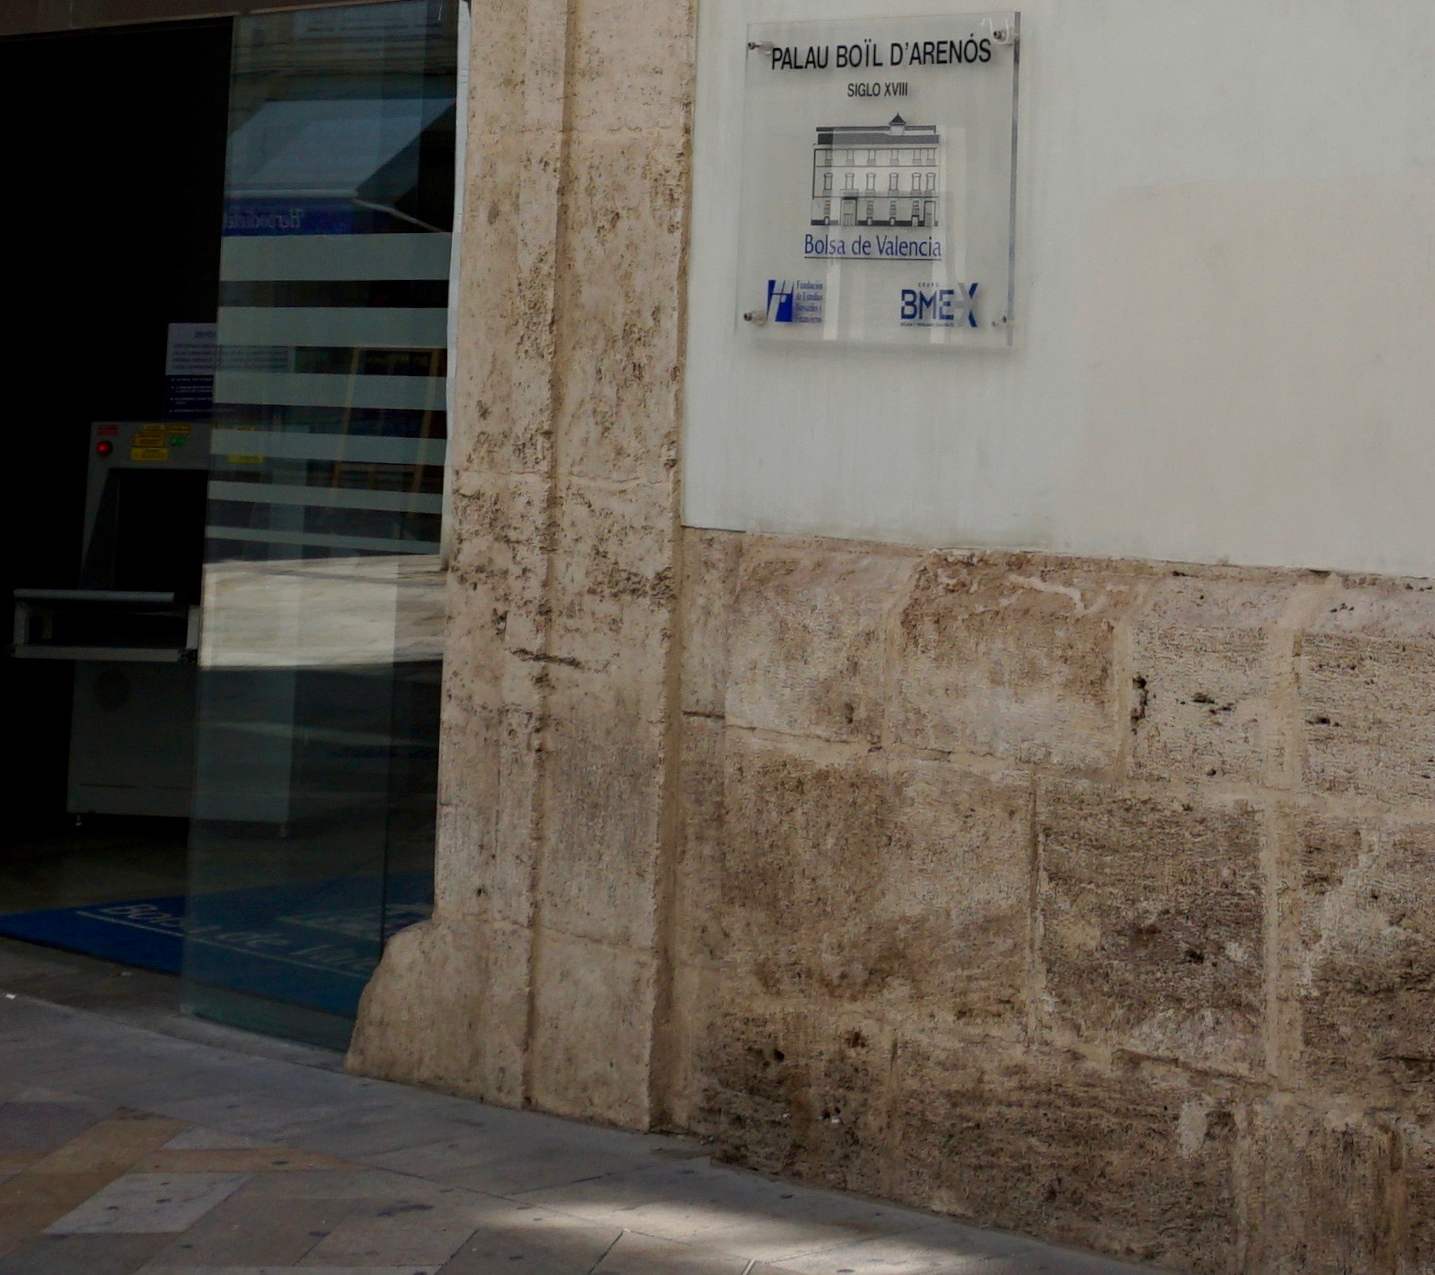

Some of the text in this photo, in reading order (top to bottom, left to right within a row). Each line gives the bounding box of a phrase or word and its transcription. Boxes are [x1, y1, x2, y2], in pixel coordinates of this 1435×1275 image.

[771, 33, 991, 70] PALAU BOÏL D'ARENÓS
[847, 81, 908, 97] SIGLO XVIII
[805, 234, 942, 257] Bolsa de Valencia
